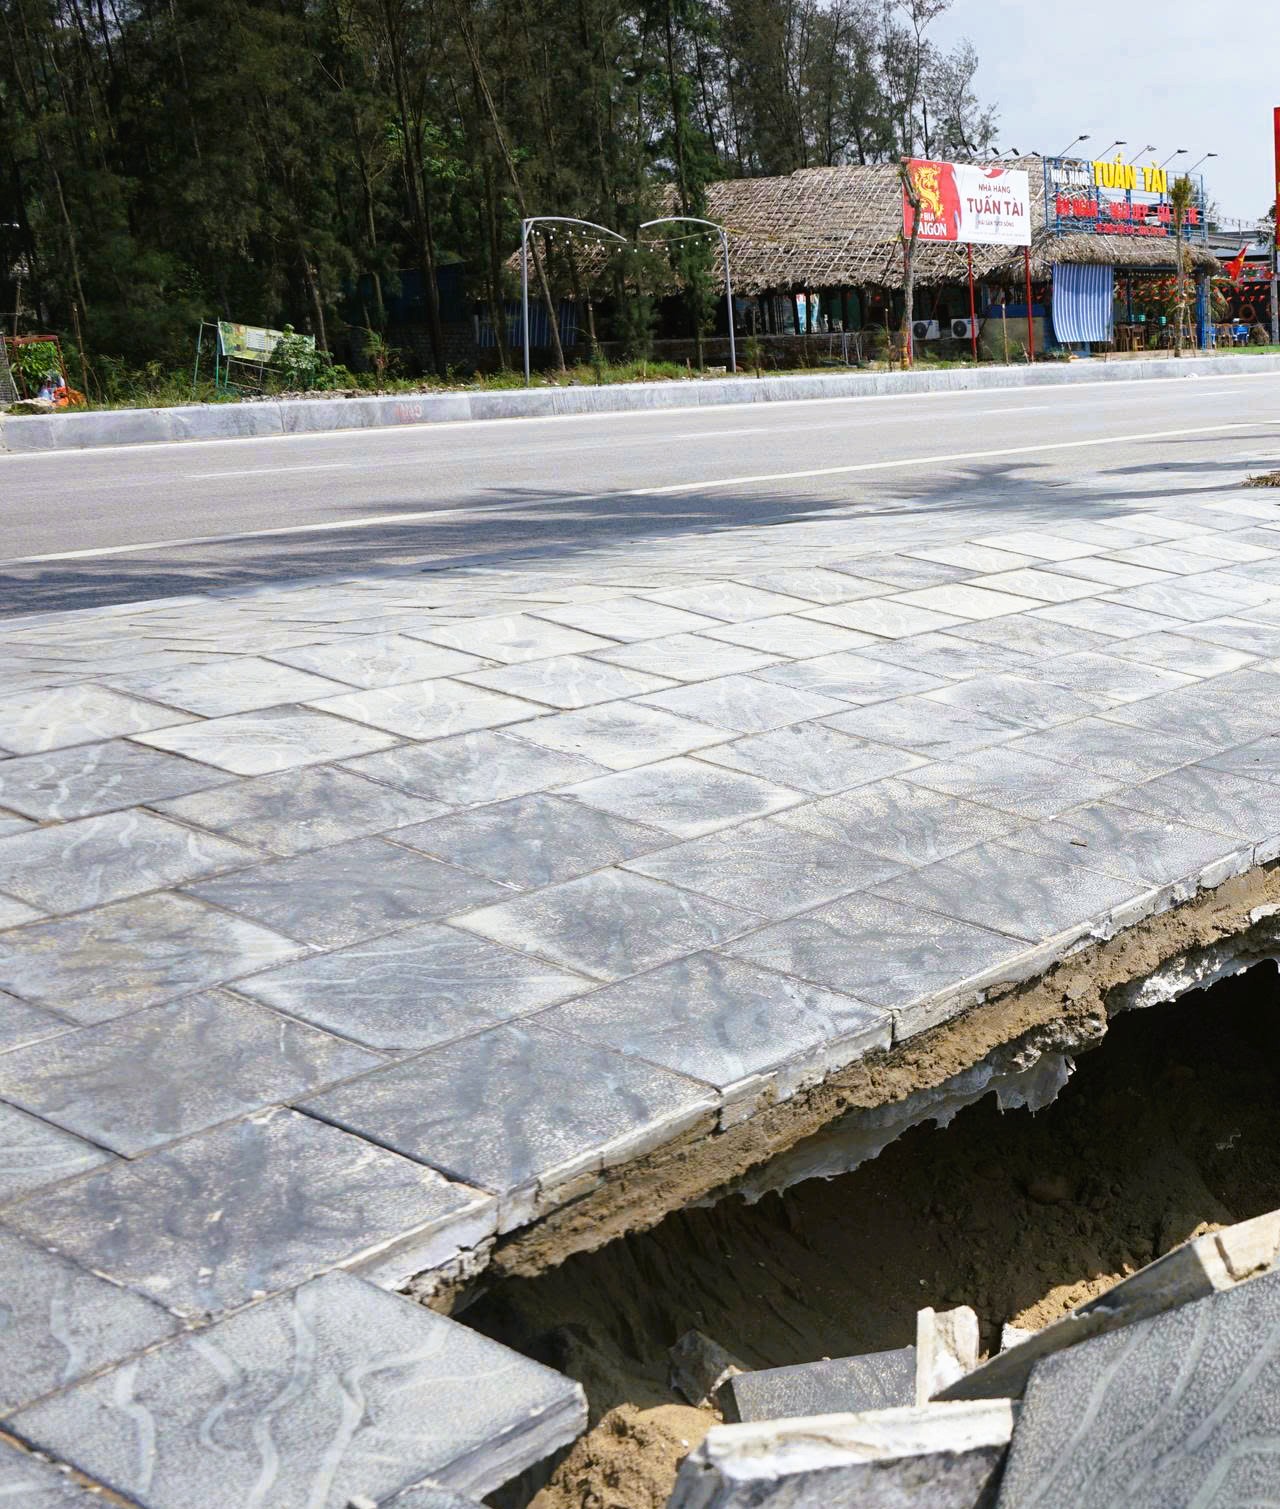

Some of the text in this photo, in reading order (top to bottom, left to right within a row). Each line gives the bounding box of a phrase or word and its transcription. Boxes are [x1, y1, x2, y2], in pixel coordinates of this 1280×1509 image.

[1092, 152, 1137, 190] TUẤN
[1142, 161, 1168, 193] TÀI
[966, 195, 1024, 216] TUẤN TÀI
[923, 212, 935, 221] BIA
[917, 221, 948, 237] AIGON
